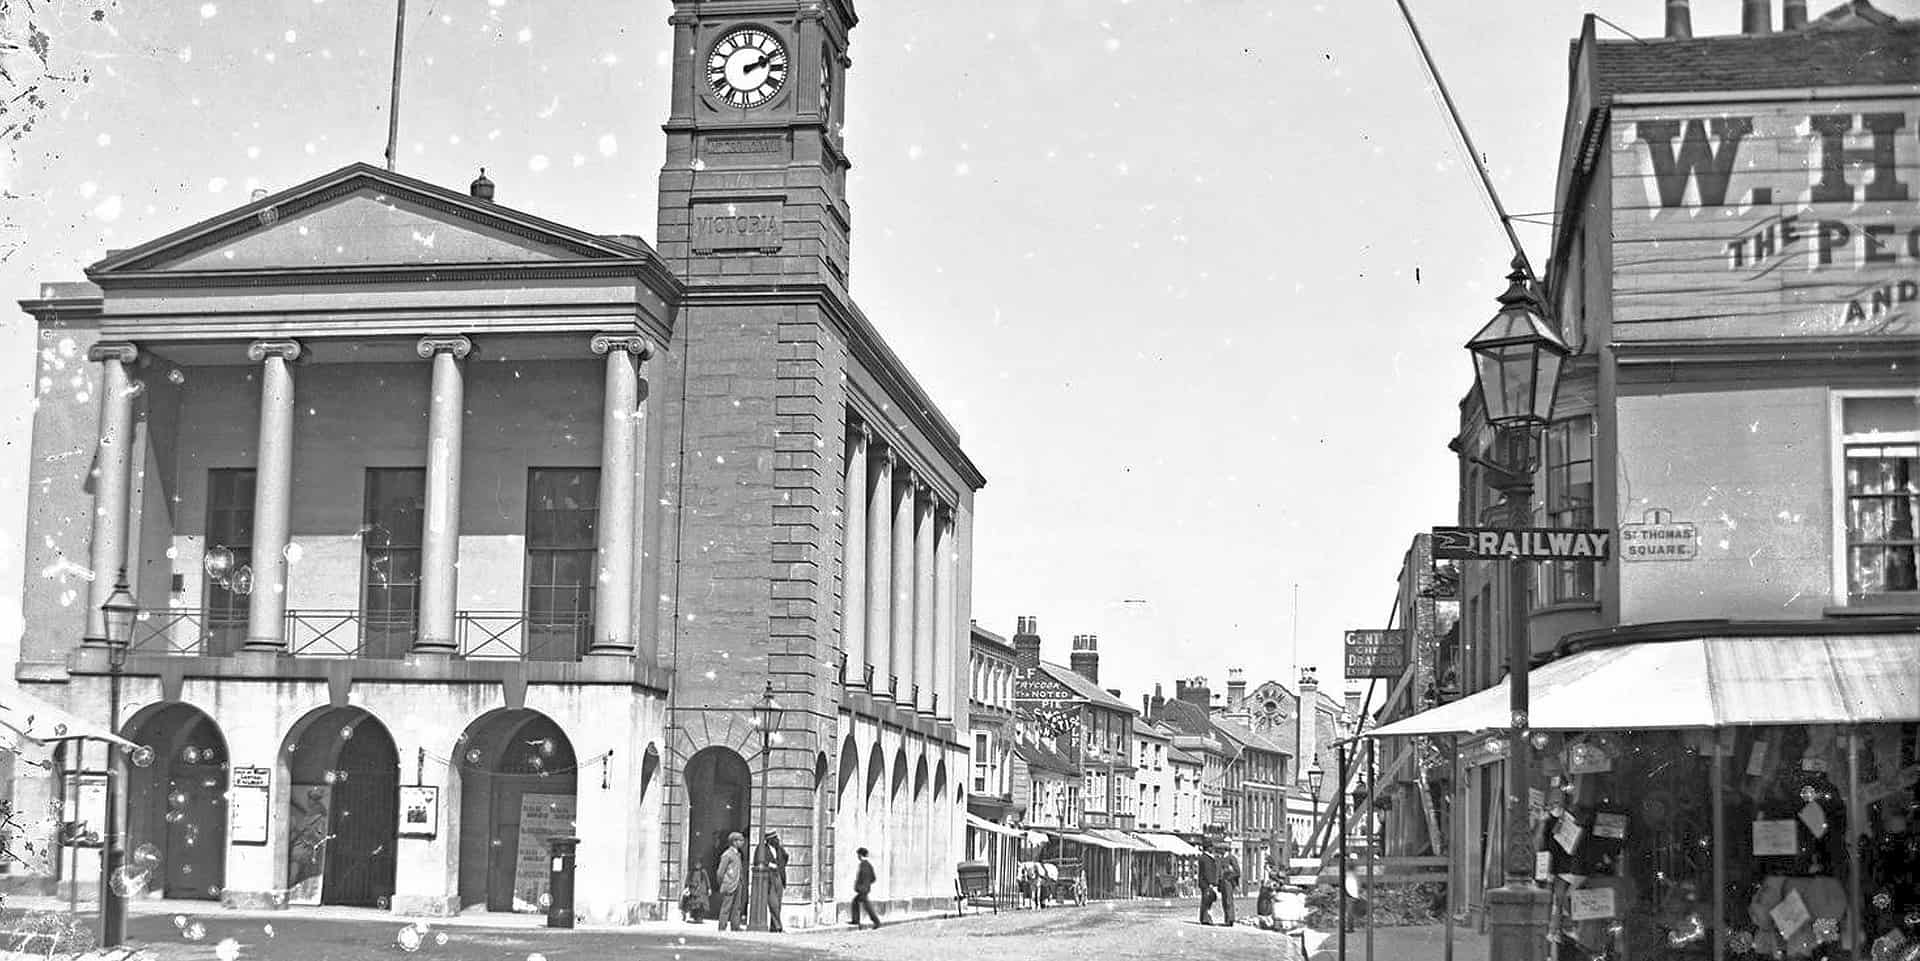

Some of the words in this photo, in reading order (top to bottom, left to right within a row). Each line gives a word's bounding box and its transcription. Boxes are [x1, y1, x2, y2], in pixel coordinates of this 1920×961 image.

[697, 215, 777, 234] VICTORIA
[1729, 215, 1799, 267] THE
[1845, 280, 1919, 323] AND
[1479, 531, 1609, 557] RAILWAY
